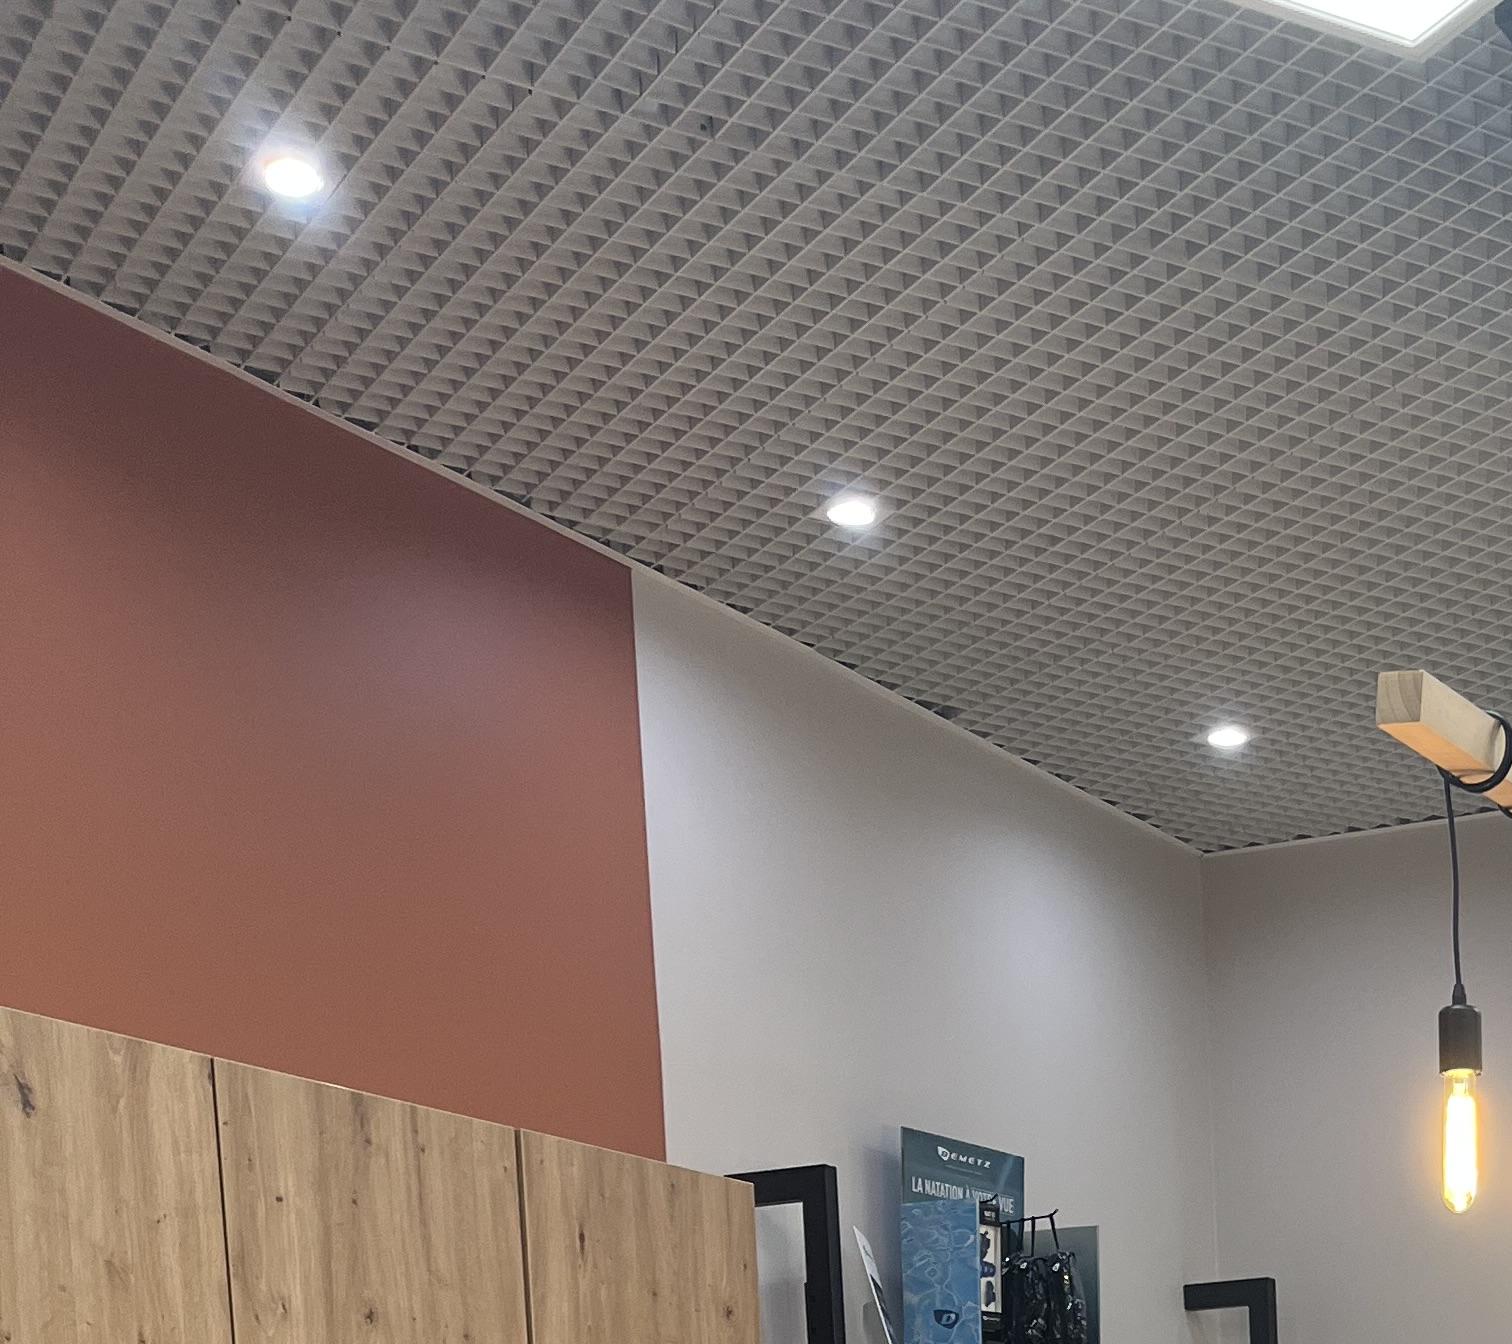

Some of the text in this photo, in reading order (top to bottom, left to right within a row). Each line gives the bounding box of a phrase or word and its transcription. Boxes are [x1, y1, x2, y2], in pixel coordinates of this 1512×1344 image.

[911, 1176, 924, 1194] LA
[924, 1179, 964, 1200] NATATION
[998, 1197, 1015, 1214] VUE
